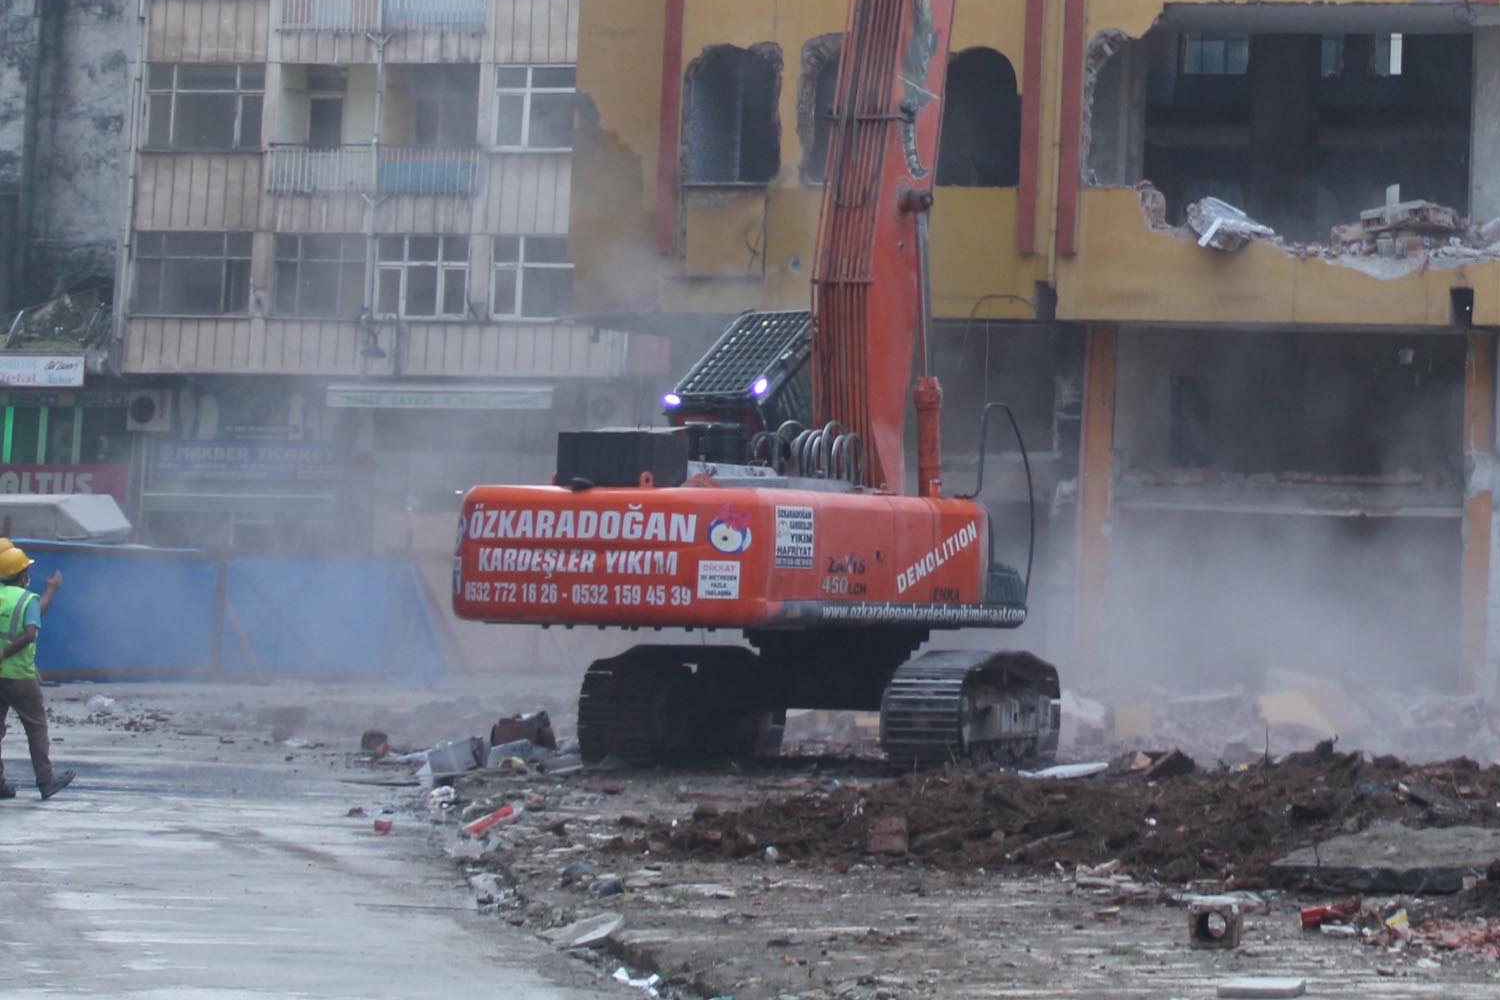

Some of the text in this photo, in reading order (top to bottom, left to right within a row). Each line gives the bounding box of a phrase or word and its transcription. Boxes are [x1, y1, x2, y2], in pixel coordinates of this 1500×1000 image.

[0, 471, 93, 494] ALTUS
[469, 503, 697, 542] ÖZKARADOĞAN
[478, 548, 678, 579] KARDEŞLER YIKIM
[896, 521, 977, 594] DEMOLITION
[465, 582, 490, 602] 0532
[494, 582, 517, 602] 772
[522, 583, 537, 603] 16
[541, 584, 558, 603] 26
[572, 584, 608, 604] 0532
[614, 585, 641, 605] 159
[646, 586, 666, 606] 45
[671, 586, 691, 606] 39
